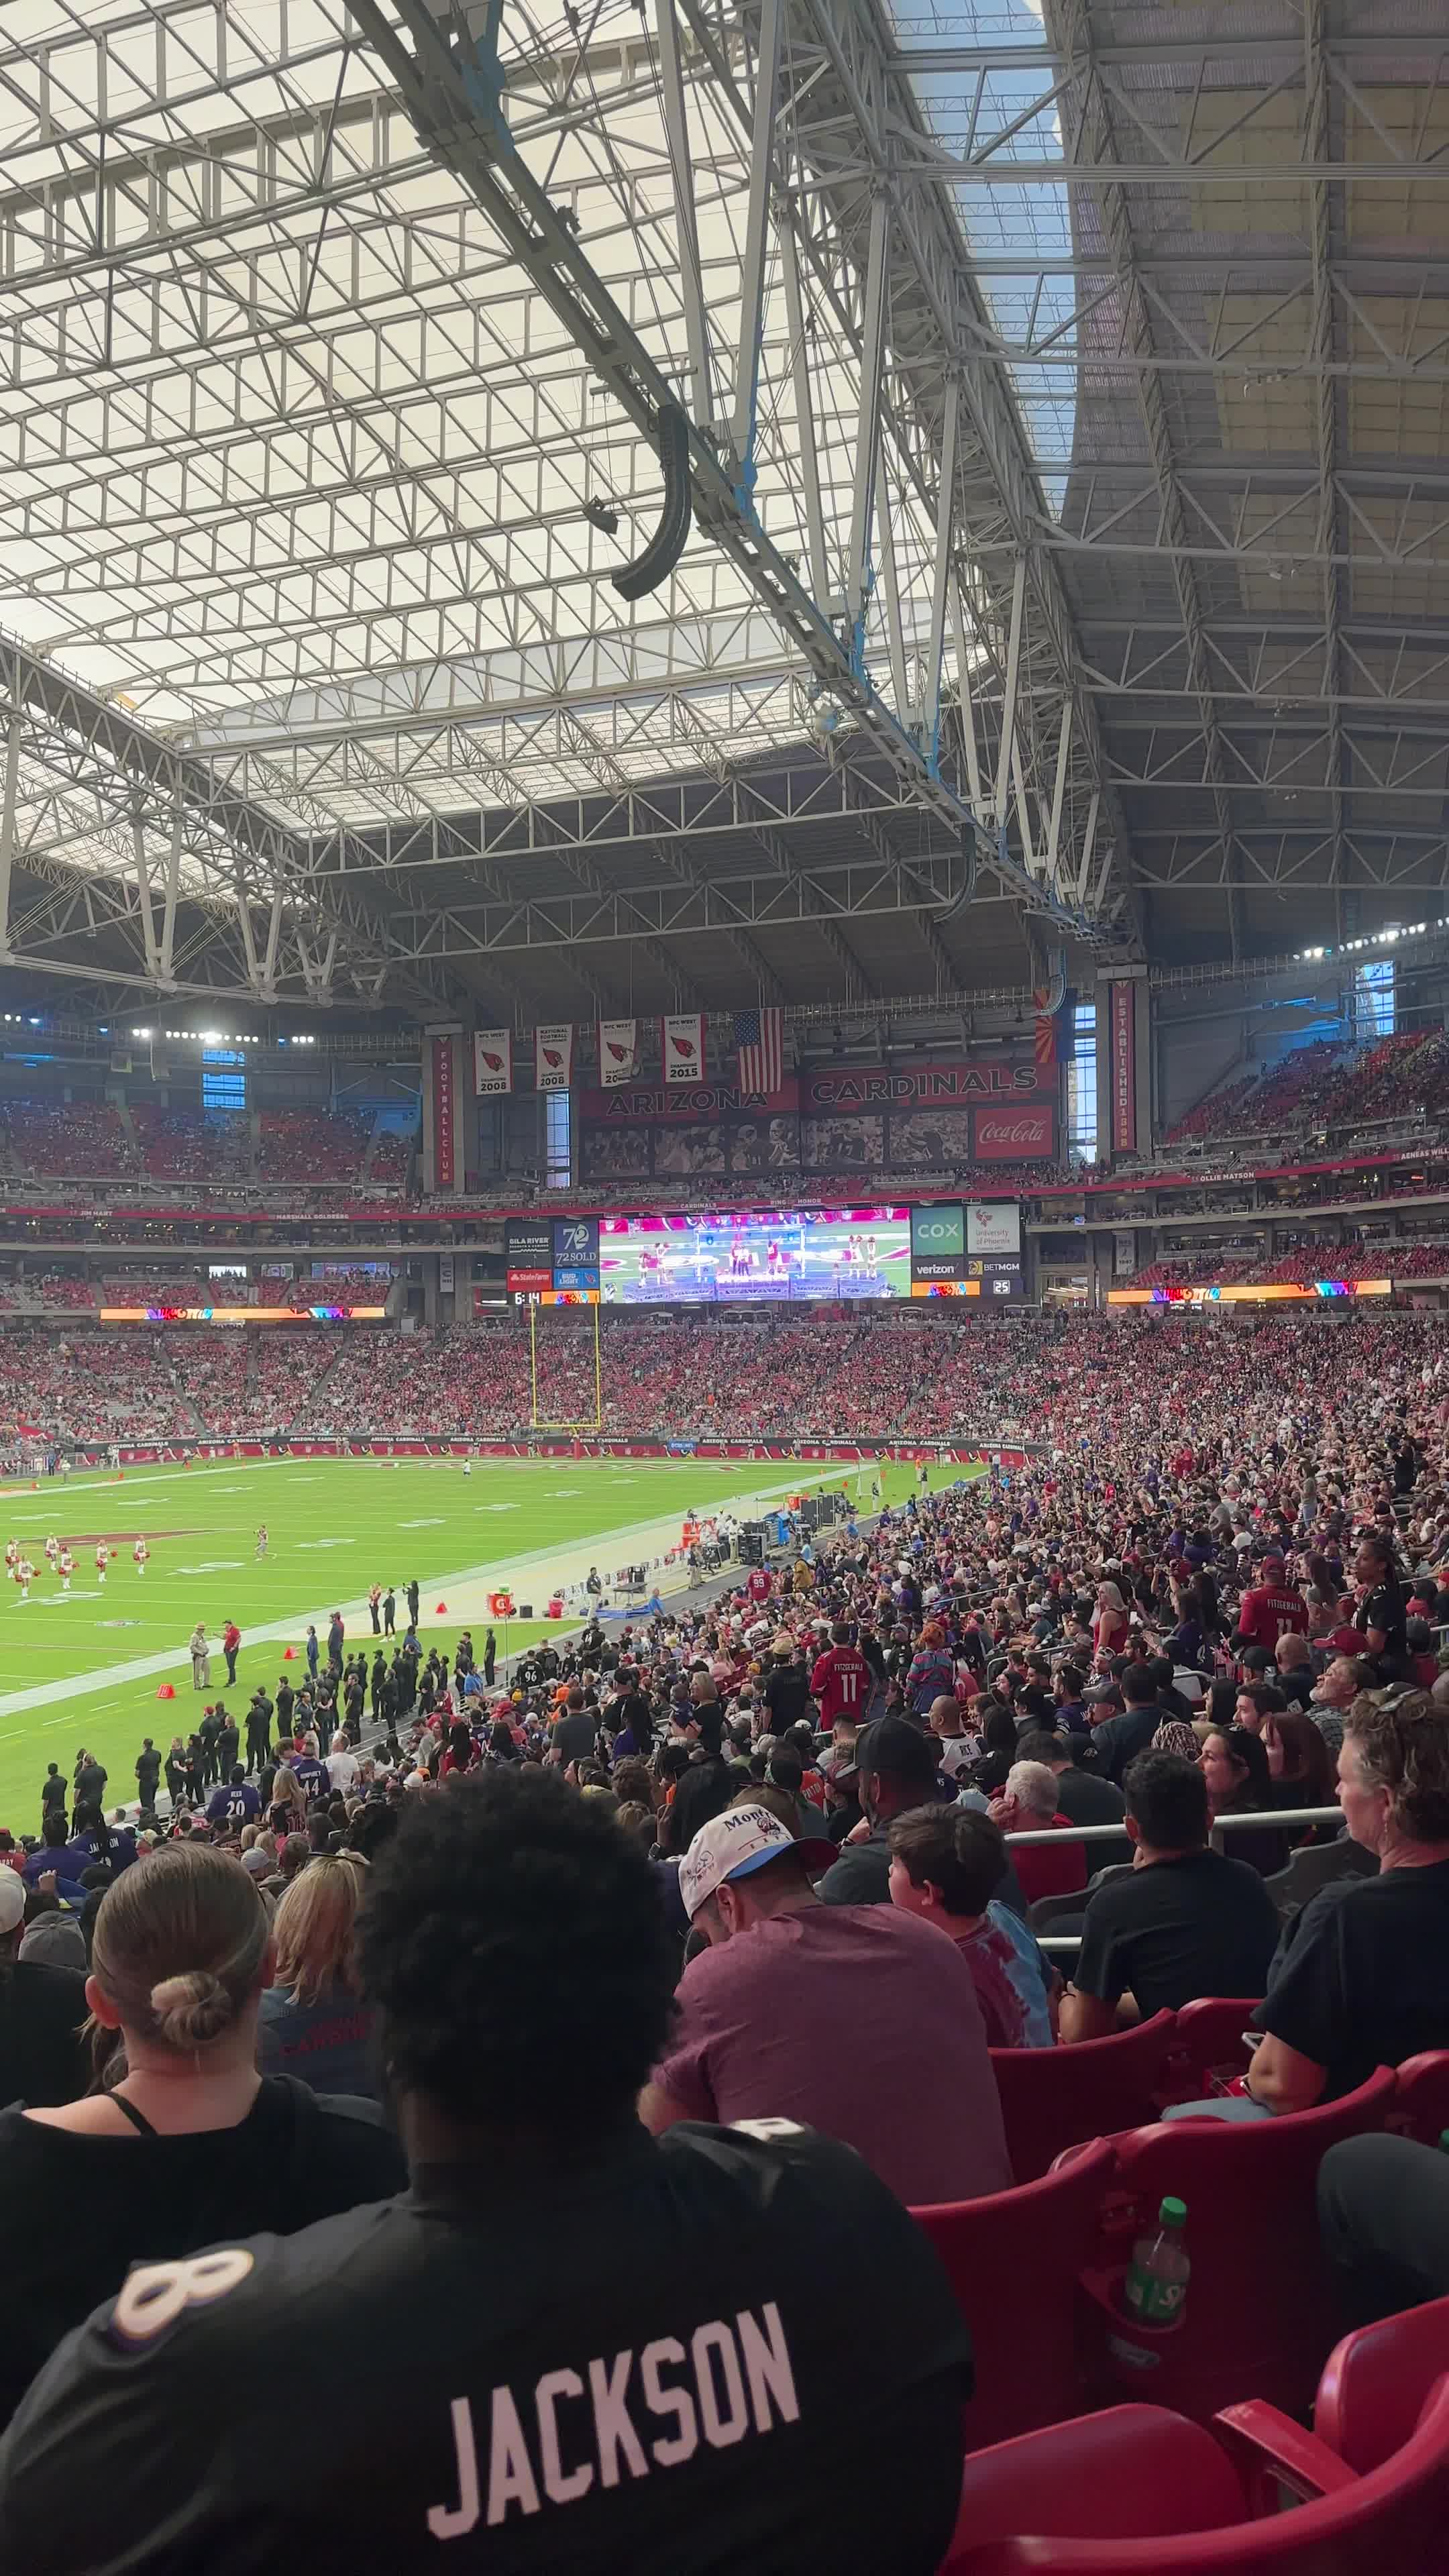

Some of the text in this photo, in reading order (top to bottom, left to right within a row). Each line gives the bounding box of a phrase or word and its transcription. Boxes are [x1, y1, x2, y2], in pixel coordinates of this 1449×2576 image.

[1118, 998, 1128, 1106] ESTABLISHED
[670, 1068, 698, 1078] 2015
[480, 1082, 506, 1091] 2008
[540, 1077, 564, 1086] 2008
[811, 1067, 1037, 1104] CARDINALS
[441, 1052, 449, 1136] FOOTBALL
[606, 1088, 768, 1116] ARIZONA
[1223, 1172, 1254, 1180] MATSON
[918, 1223, 959, 1238] COX
[975, 1228, 1009, 1237] University
[983, 1236, 1010, 1244] Phoenix
[556, 1252, 596, 1265] 72SOLD
[917, 1264, 955, 1275] verizon
[983, 1263, 1020, 1272] BETMGM
[994, 1281, 1009, 1293] 25
[515, 1292, 540, 1305] 6:14
[753, 1578, 765, 1589] 99
[496, 1598, 506, 1610] G
[1277, 1618, 1292, 1638] 11
[834, 1663, 863, 1672] FITZGERALD
[525, 1671, 537, 1682] 96
[841, 1673, 857, 1703] 11
[227, 1800, 246, 1818] 20
[112, 2248, 255, 2341] 8
[427, 2302, 800, 2540] JACKSON
